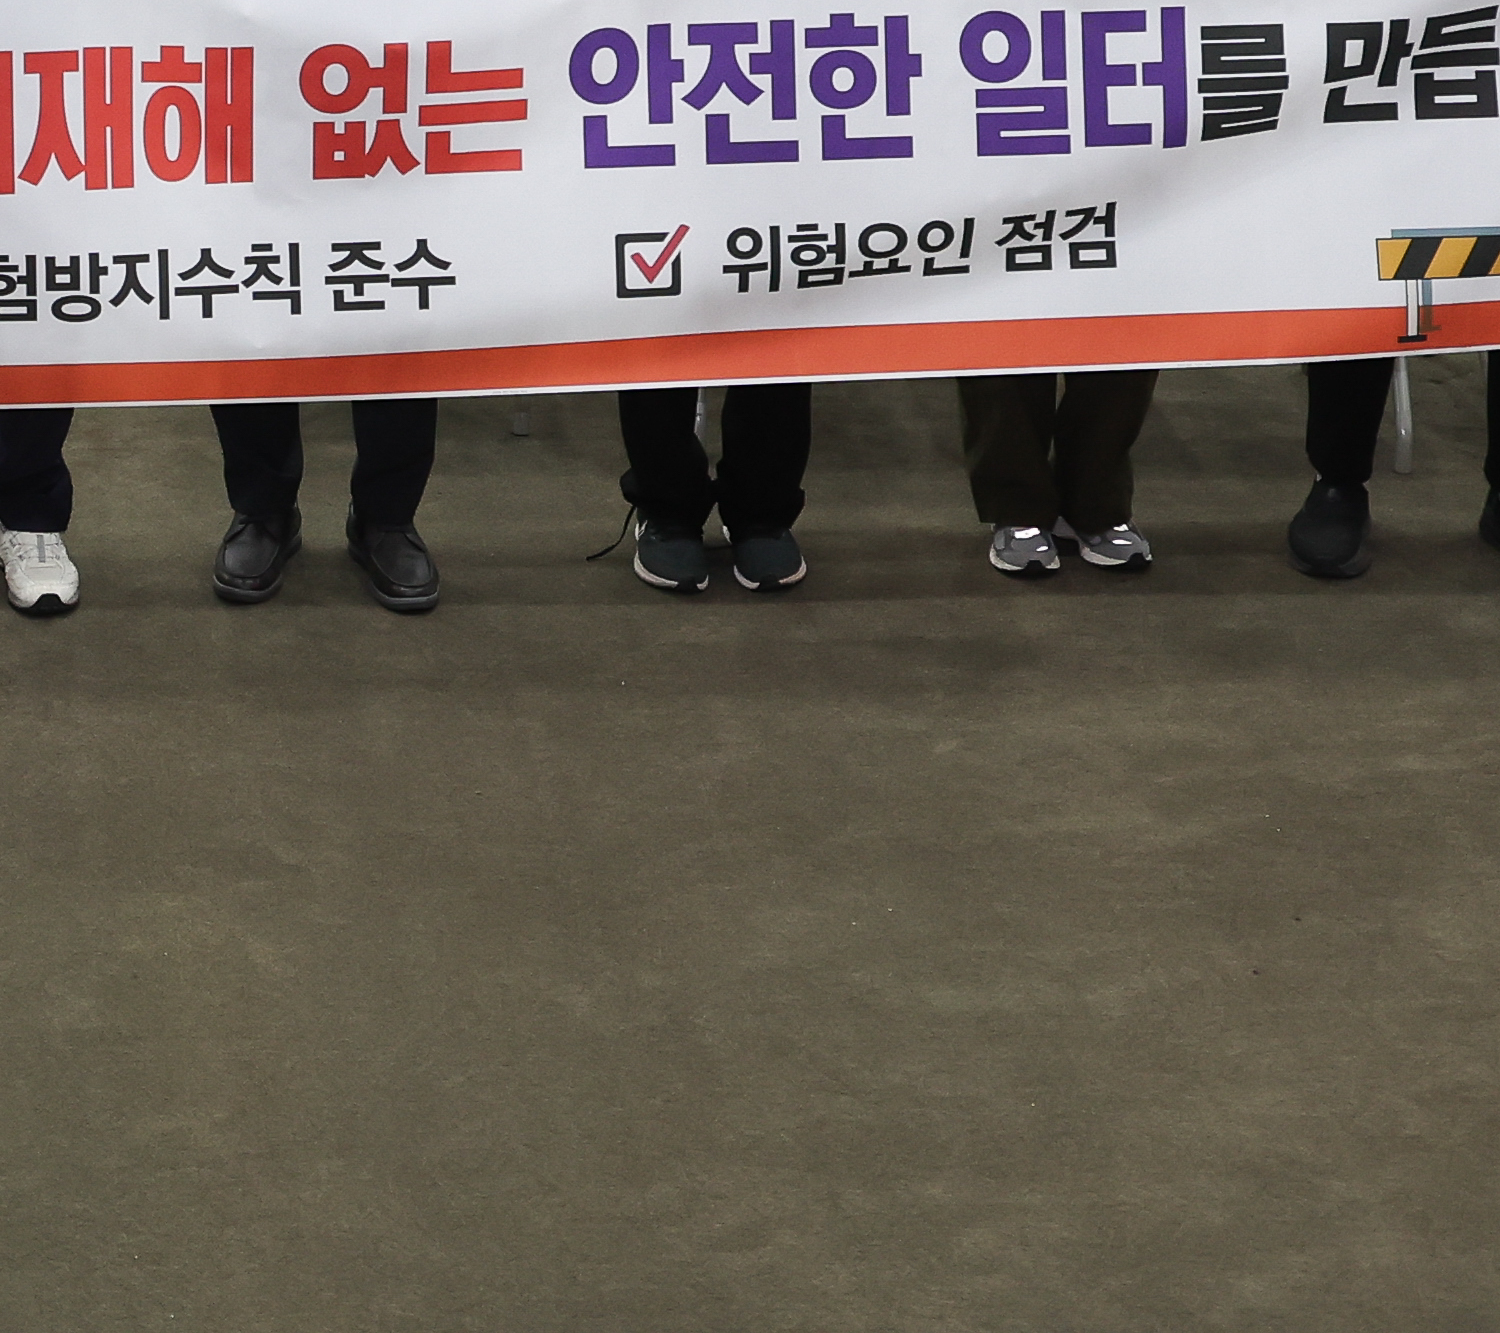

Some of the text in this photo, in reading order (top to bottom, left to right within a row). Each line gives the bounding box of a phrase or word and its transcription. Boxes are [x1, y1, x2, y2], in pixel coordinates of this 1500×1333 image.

[297, 39, 528, 181] 없는
[568, 13, 922, 170] 안전한
[958, 5, 1289, 158] 일터를
[324, 236, 457, 312] 준수
[721, 215, 977, 294] 위험요인
[994, 201, 1120, 273] 점검
